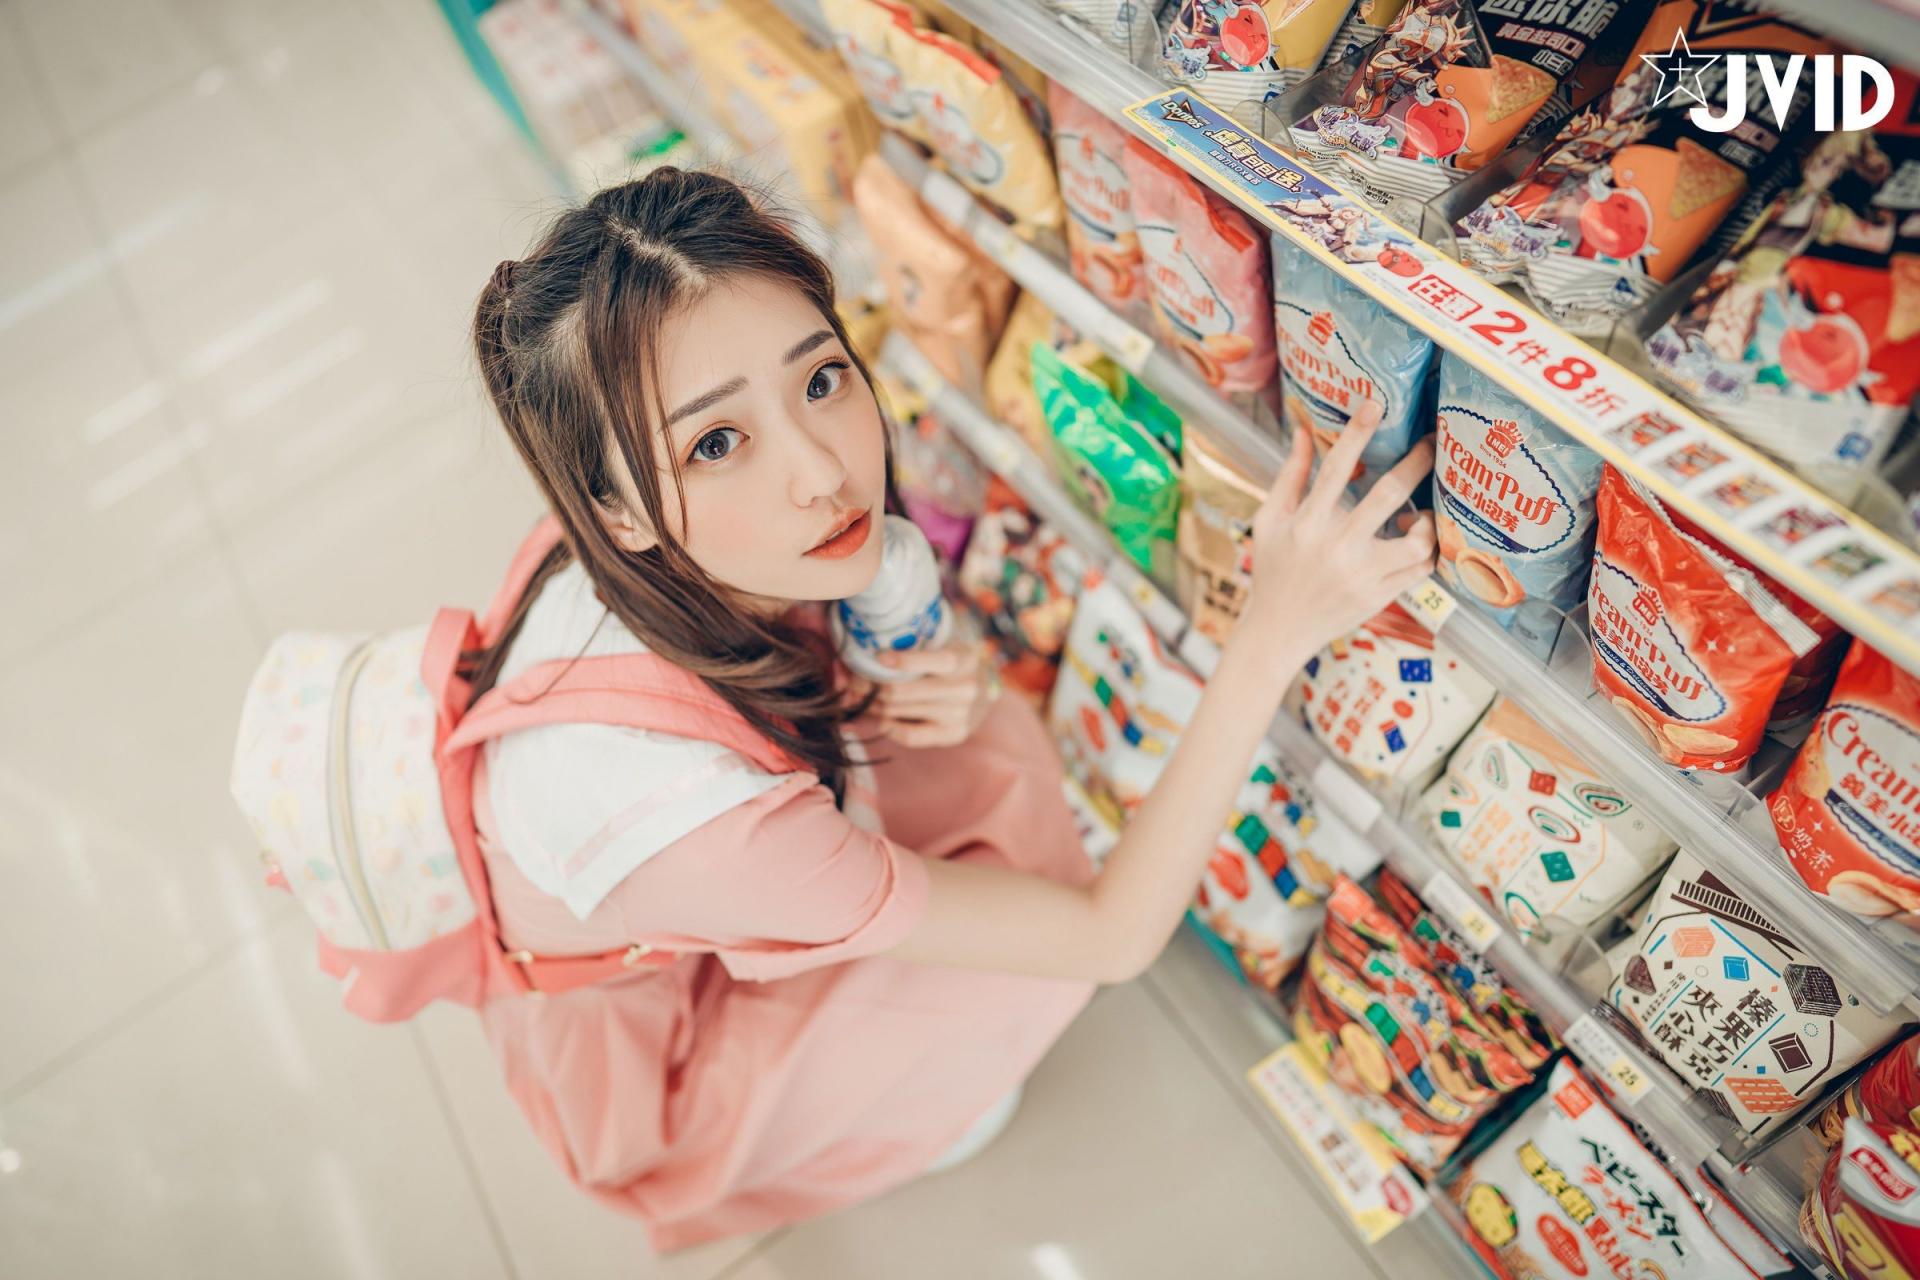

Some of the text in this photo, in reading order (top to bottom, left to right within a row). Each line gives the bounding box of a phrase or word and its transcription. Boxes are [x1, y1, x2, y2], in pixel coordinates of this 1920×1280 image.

[1162, 100, 1204, 129] Doritos
[1495, 471, 1562, 526] Puff
[1472, 514, 1505, 542] Delicious
[1654, 985, 1723, 1053] 夾心酥
[1617, 1064, 1635, 1087] 25
[1580, 1137, 1684, 1257] ベビースター
[1583, 1165, 1653, 1241] ラーメン
